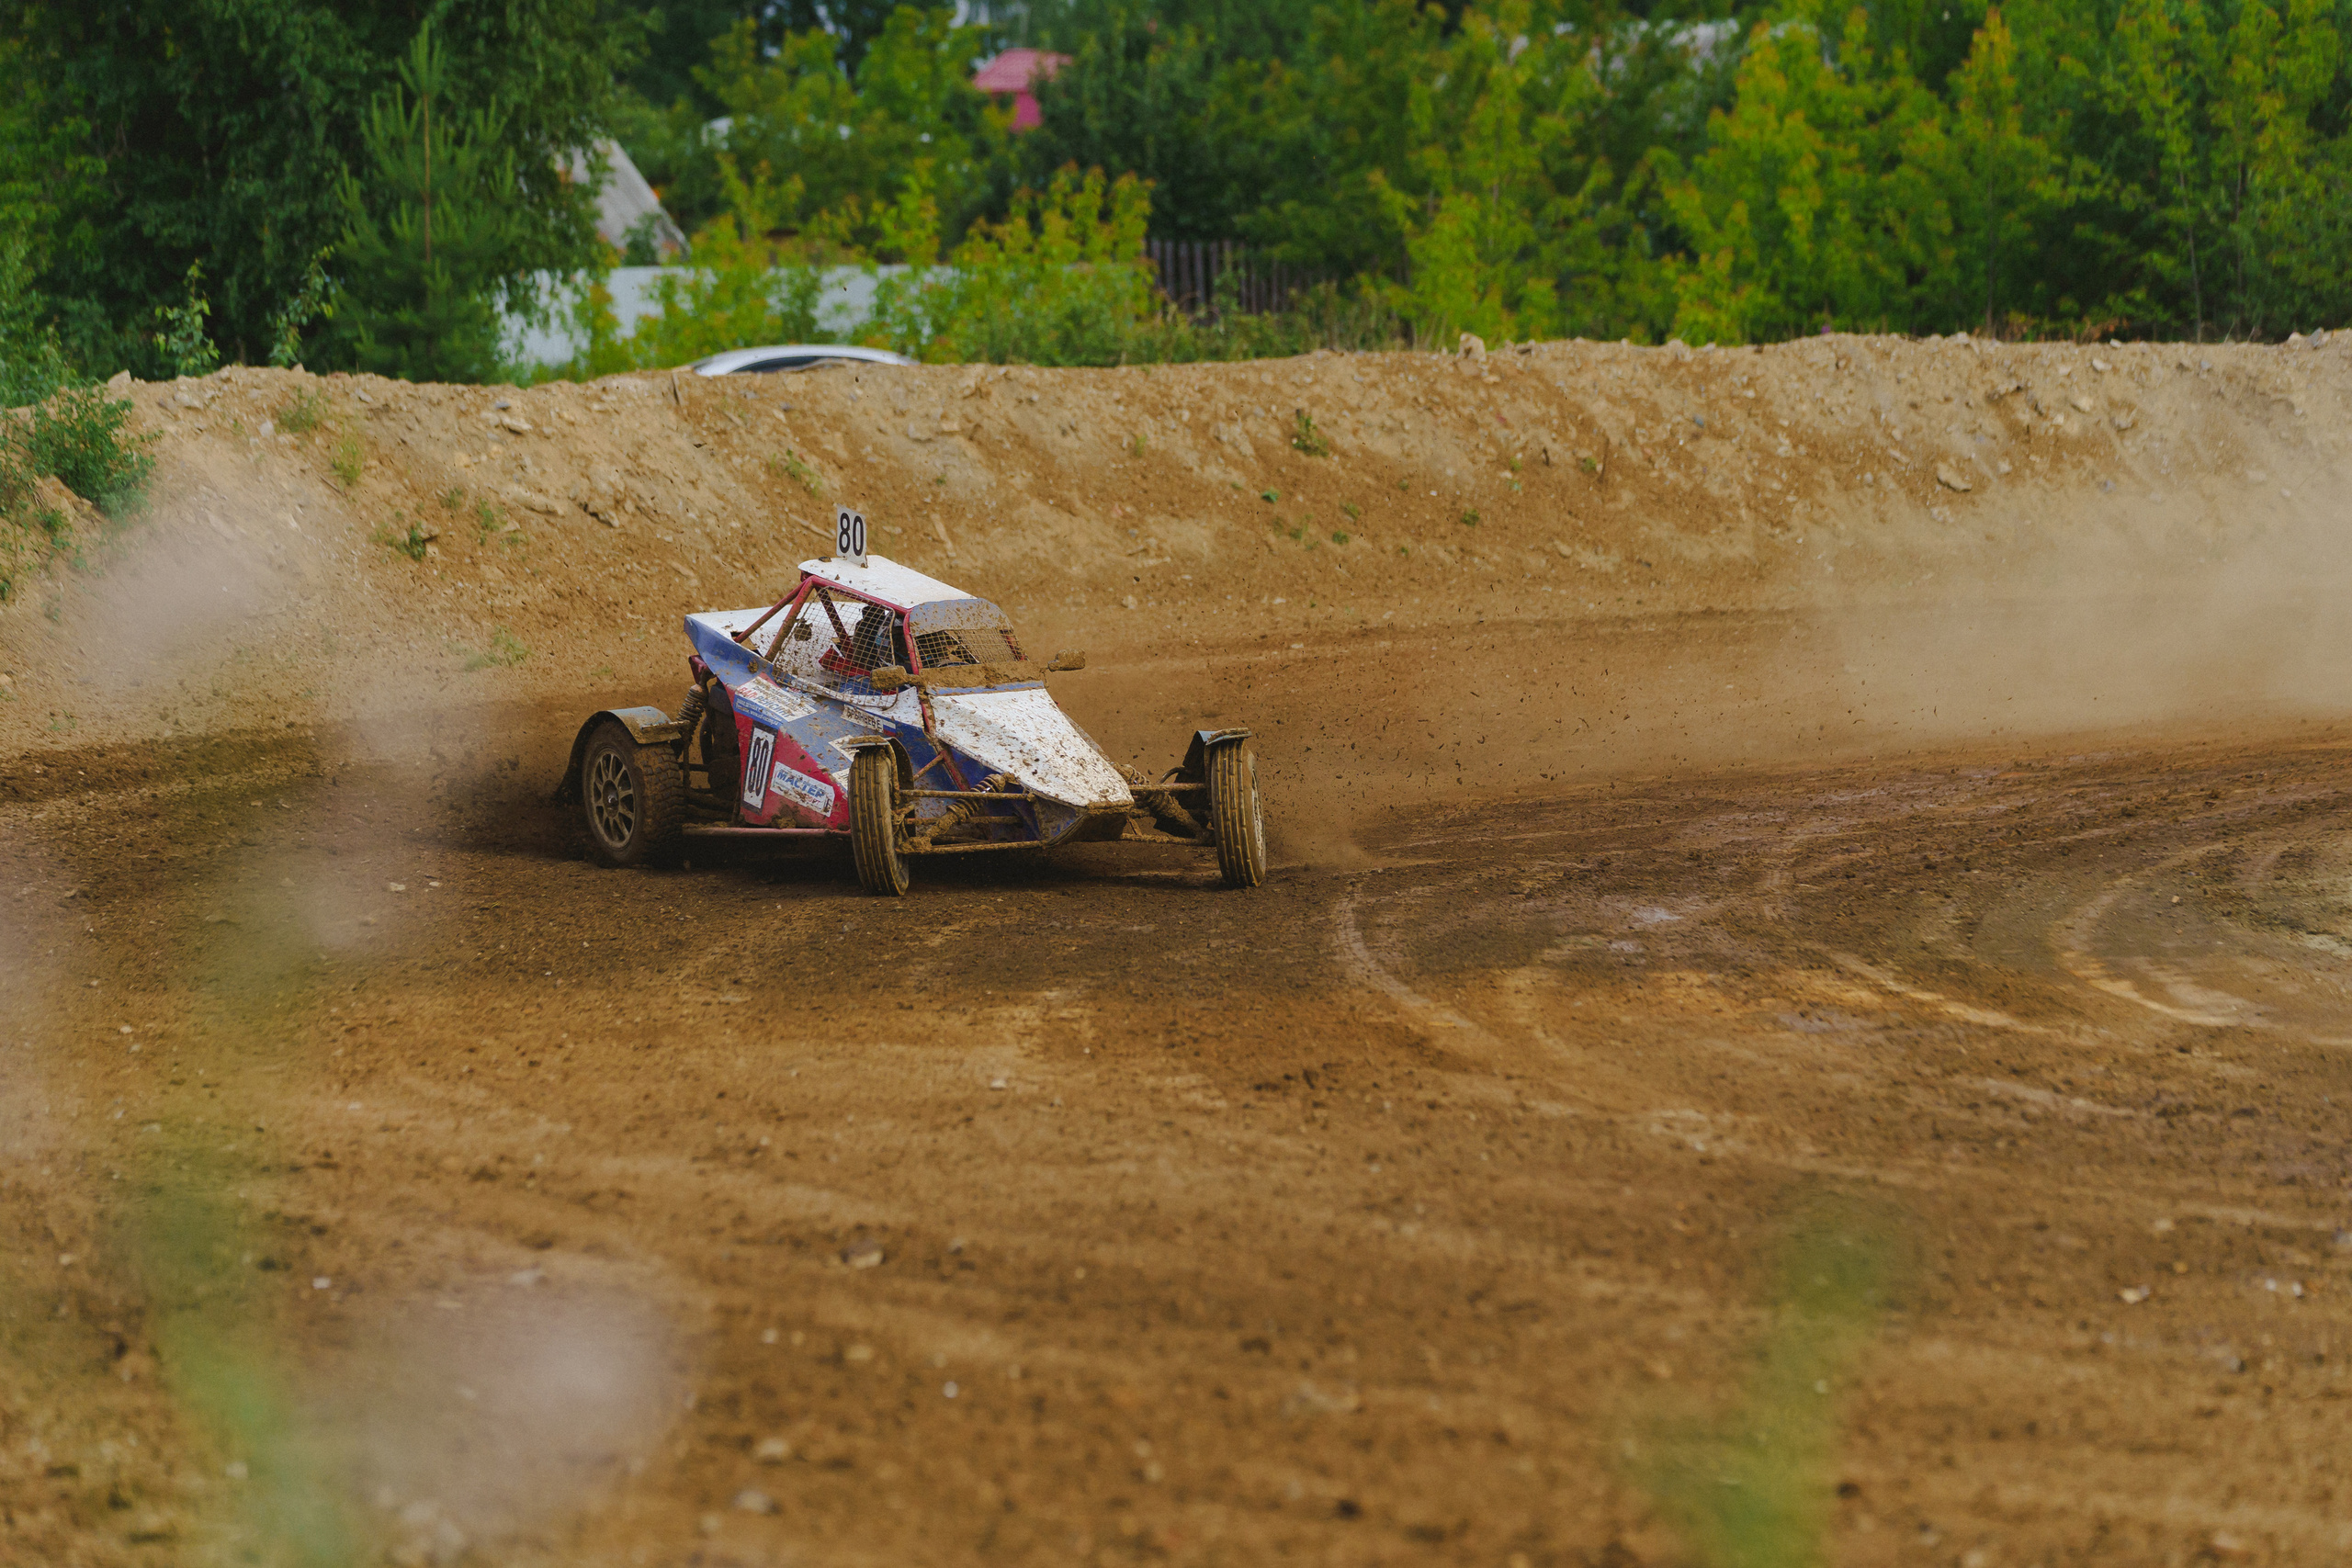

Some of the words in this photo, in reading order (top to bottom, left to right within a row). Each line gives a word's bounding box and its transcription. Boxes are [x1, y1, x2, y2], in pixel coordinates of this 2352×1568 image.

[839, 513, 864, 556] 80
[748, 736, 770, 797] 80
[777, 769, 826, 798] МАСТЕР
